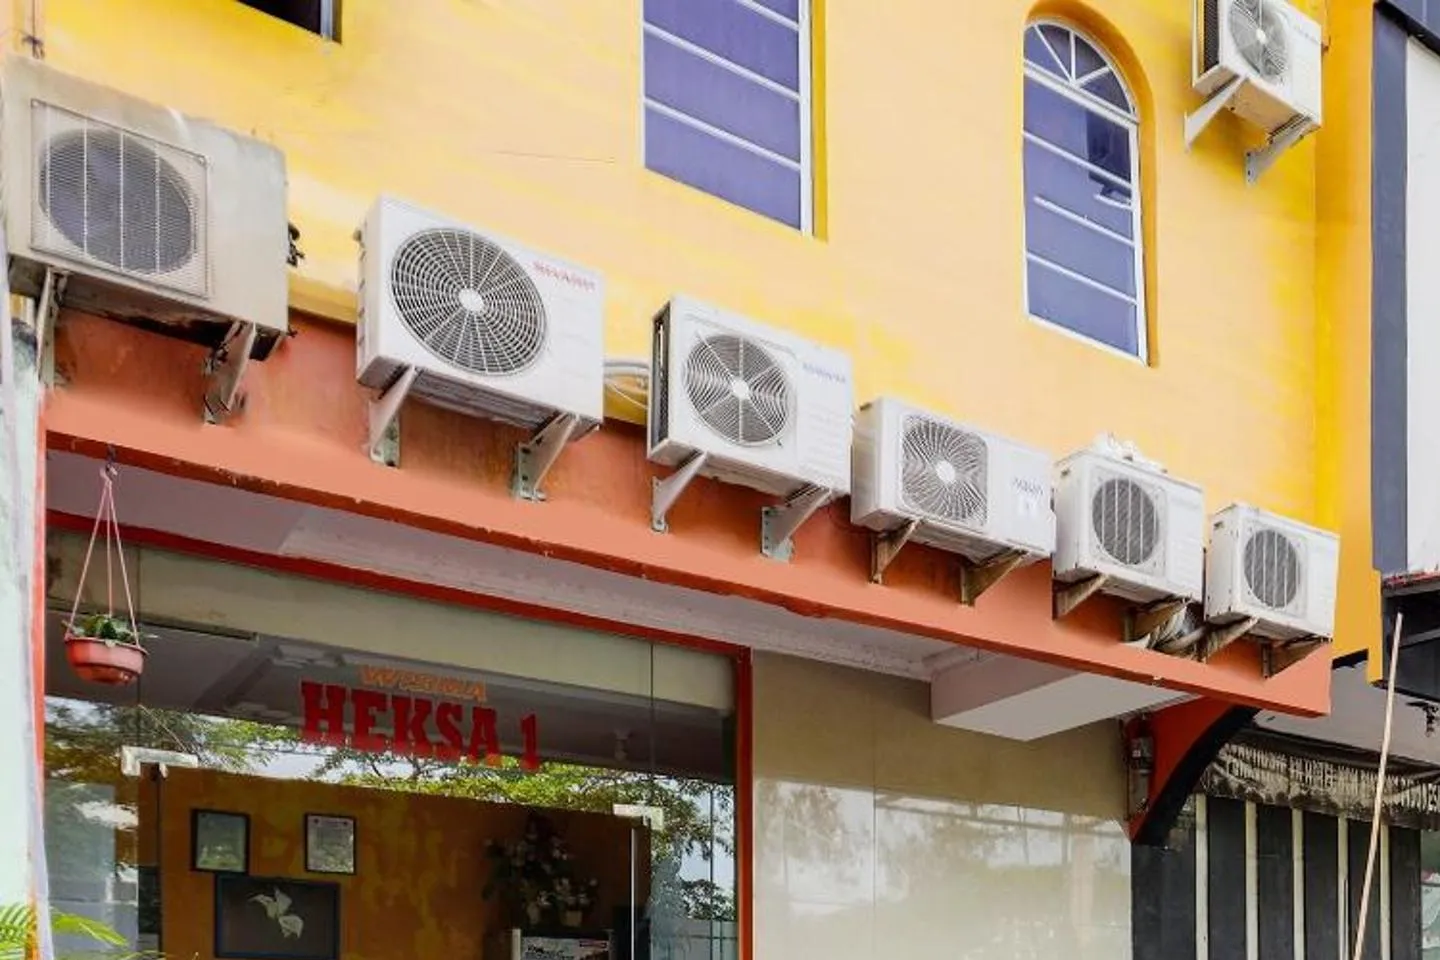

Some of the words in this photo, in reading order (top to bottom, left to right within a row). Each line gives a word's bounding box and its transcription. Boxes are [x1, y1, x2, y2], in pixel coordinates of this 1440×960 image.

[362, 665, 486, 701] WISMA
[301, 681, 502, 766] HEKSA
[520, 710, 541, 774] 1
